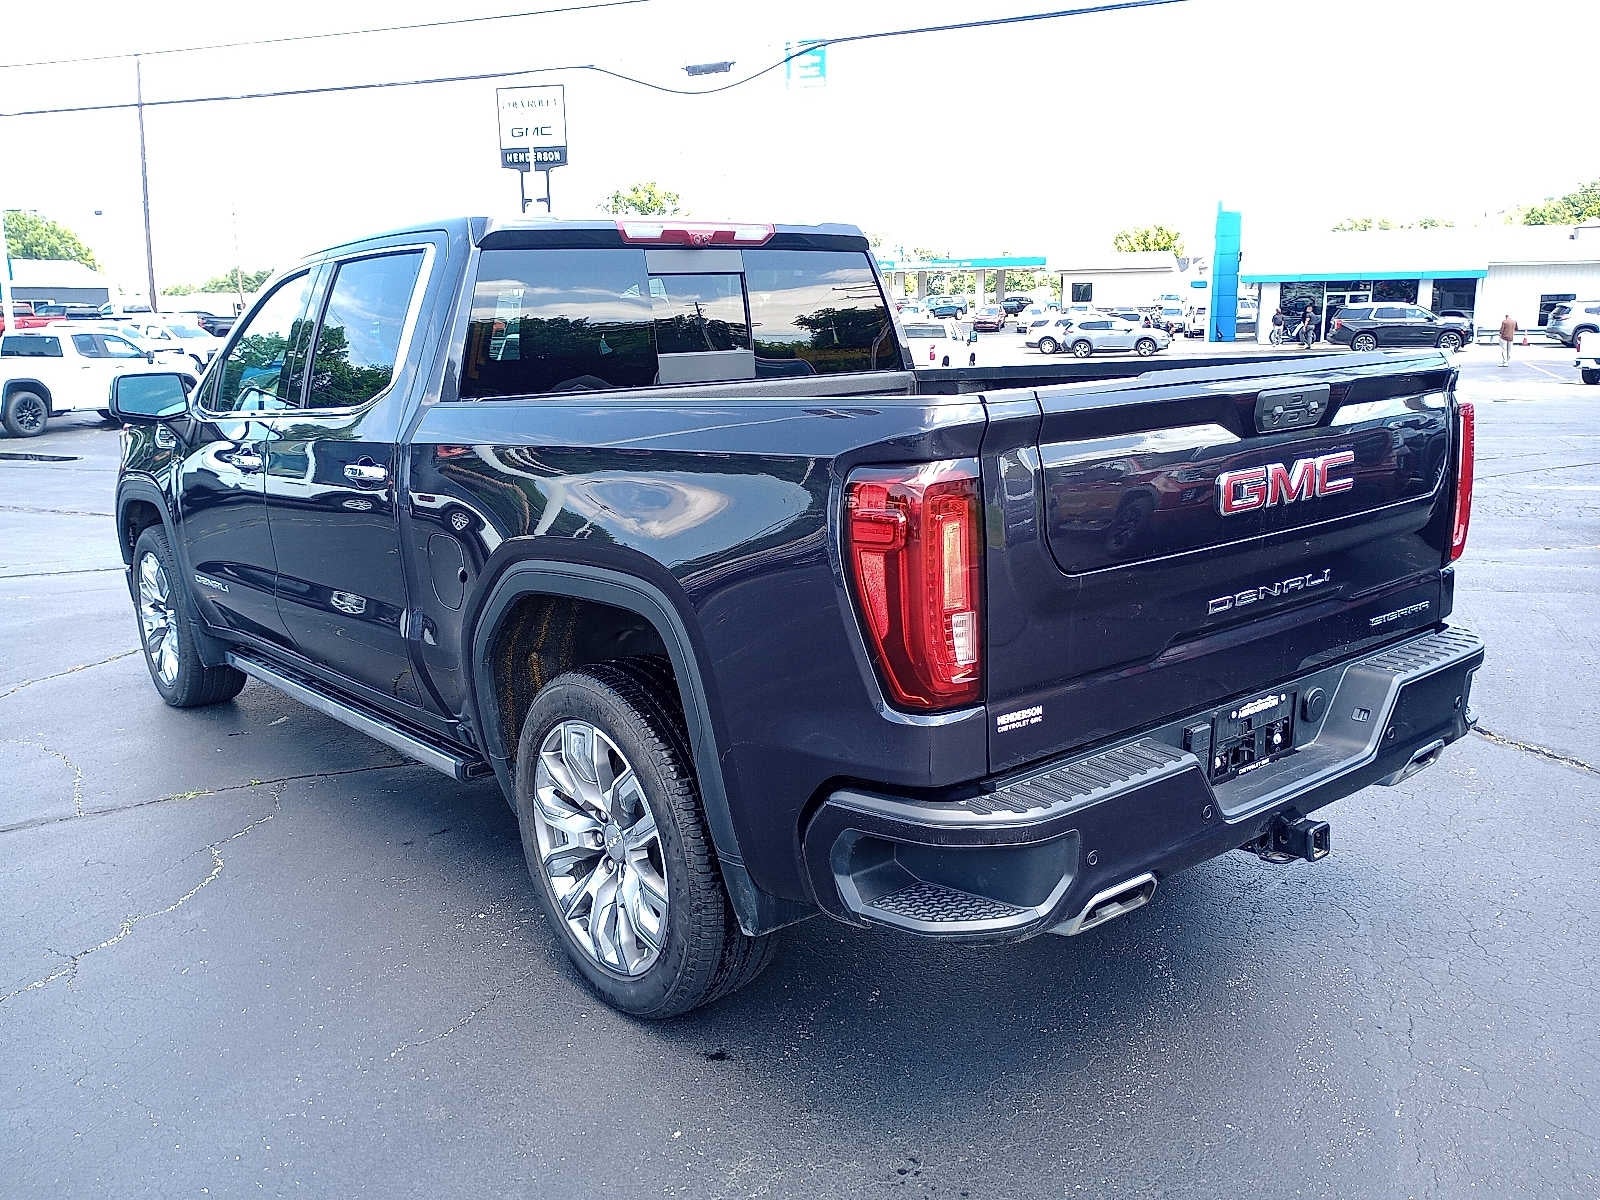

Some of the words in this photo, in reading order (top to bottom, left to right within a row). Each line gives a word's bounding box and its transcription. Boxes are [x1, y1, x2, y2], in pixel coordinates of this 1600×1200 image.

[511, 125, 553, 138] GMC
[1215, 450, 1355, 517] GMC
[1208, 568, 1331, 615] DENALI
[1369, 600, 1431, 626] SIERRA
[996, 705, 1043, 726] HENDERSON
